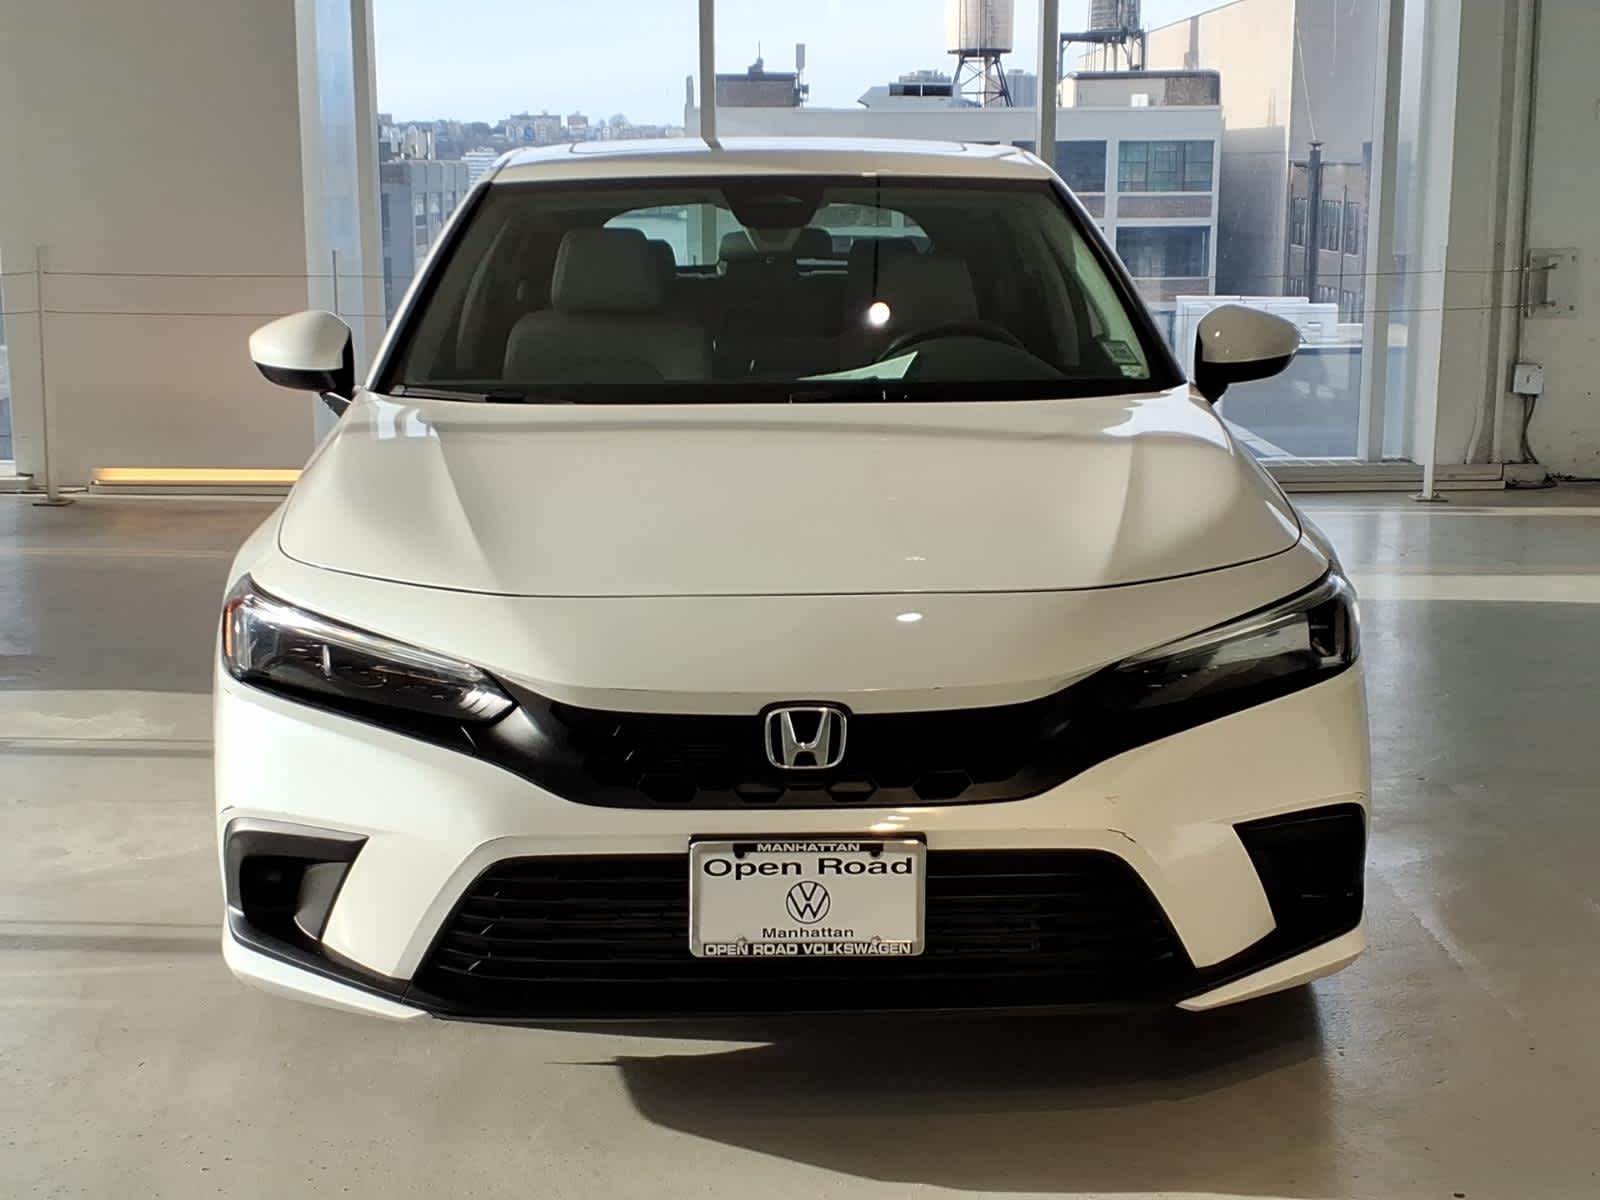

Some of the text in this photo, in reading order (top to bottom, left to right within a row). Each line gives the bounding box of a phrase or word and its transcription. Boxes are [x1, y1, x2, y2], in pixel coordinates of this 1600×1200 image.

[757, 843, 860, 852] MANHATTAN
[704, 857, 912, 880] Open Road
[762, 928, 854, 939] Manhattan
[705, 943, 911, 955] OPEN ROAD VOLKSWAGEN
